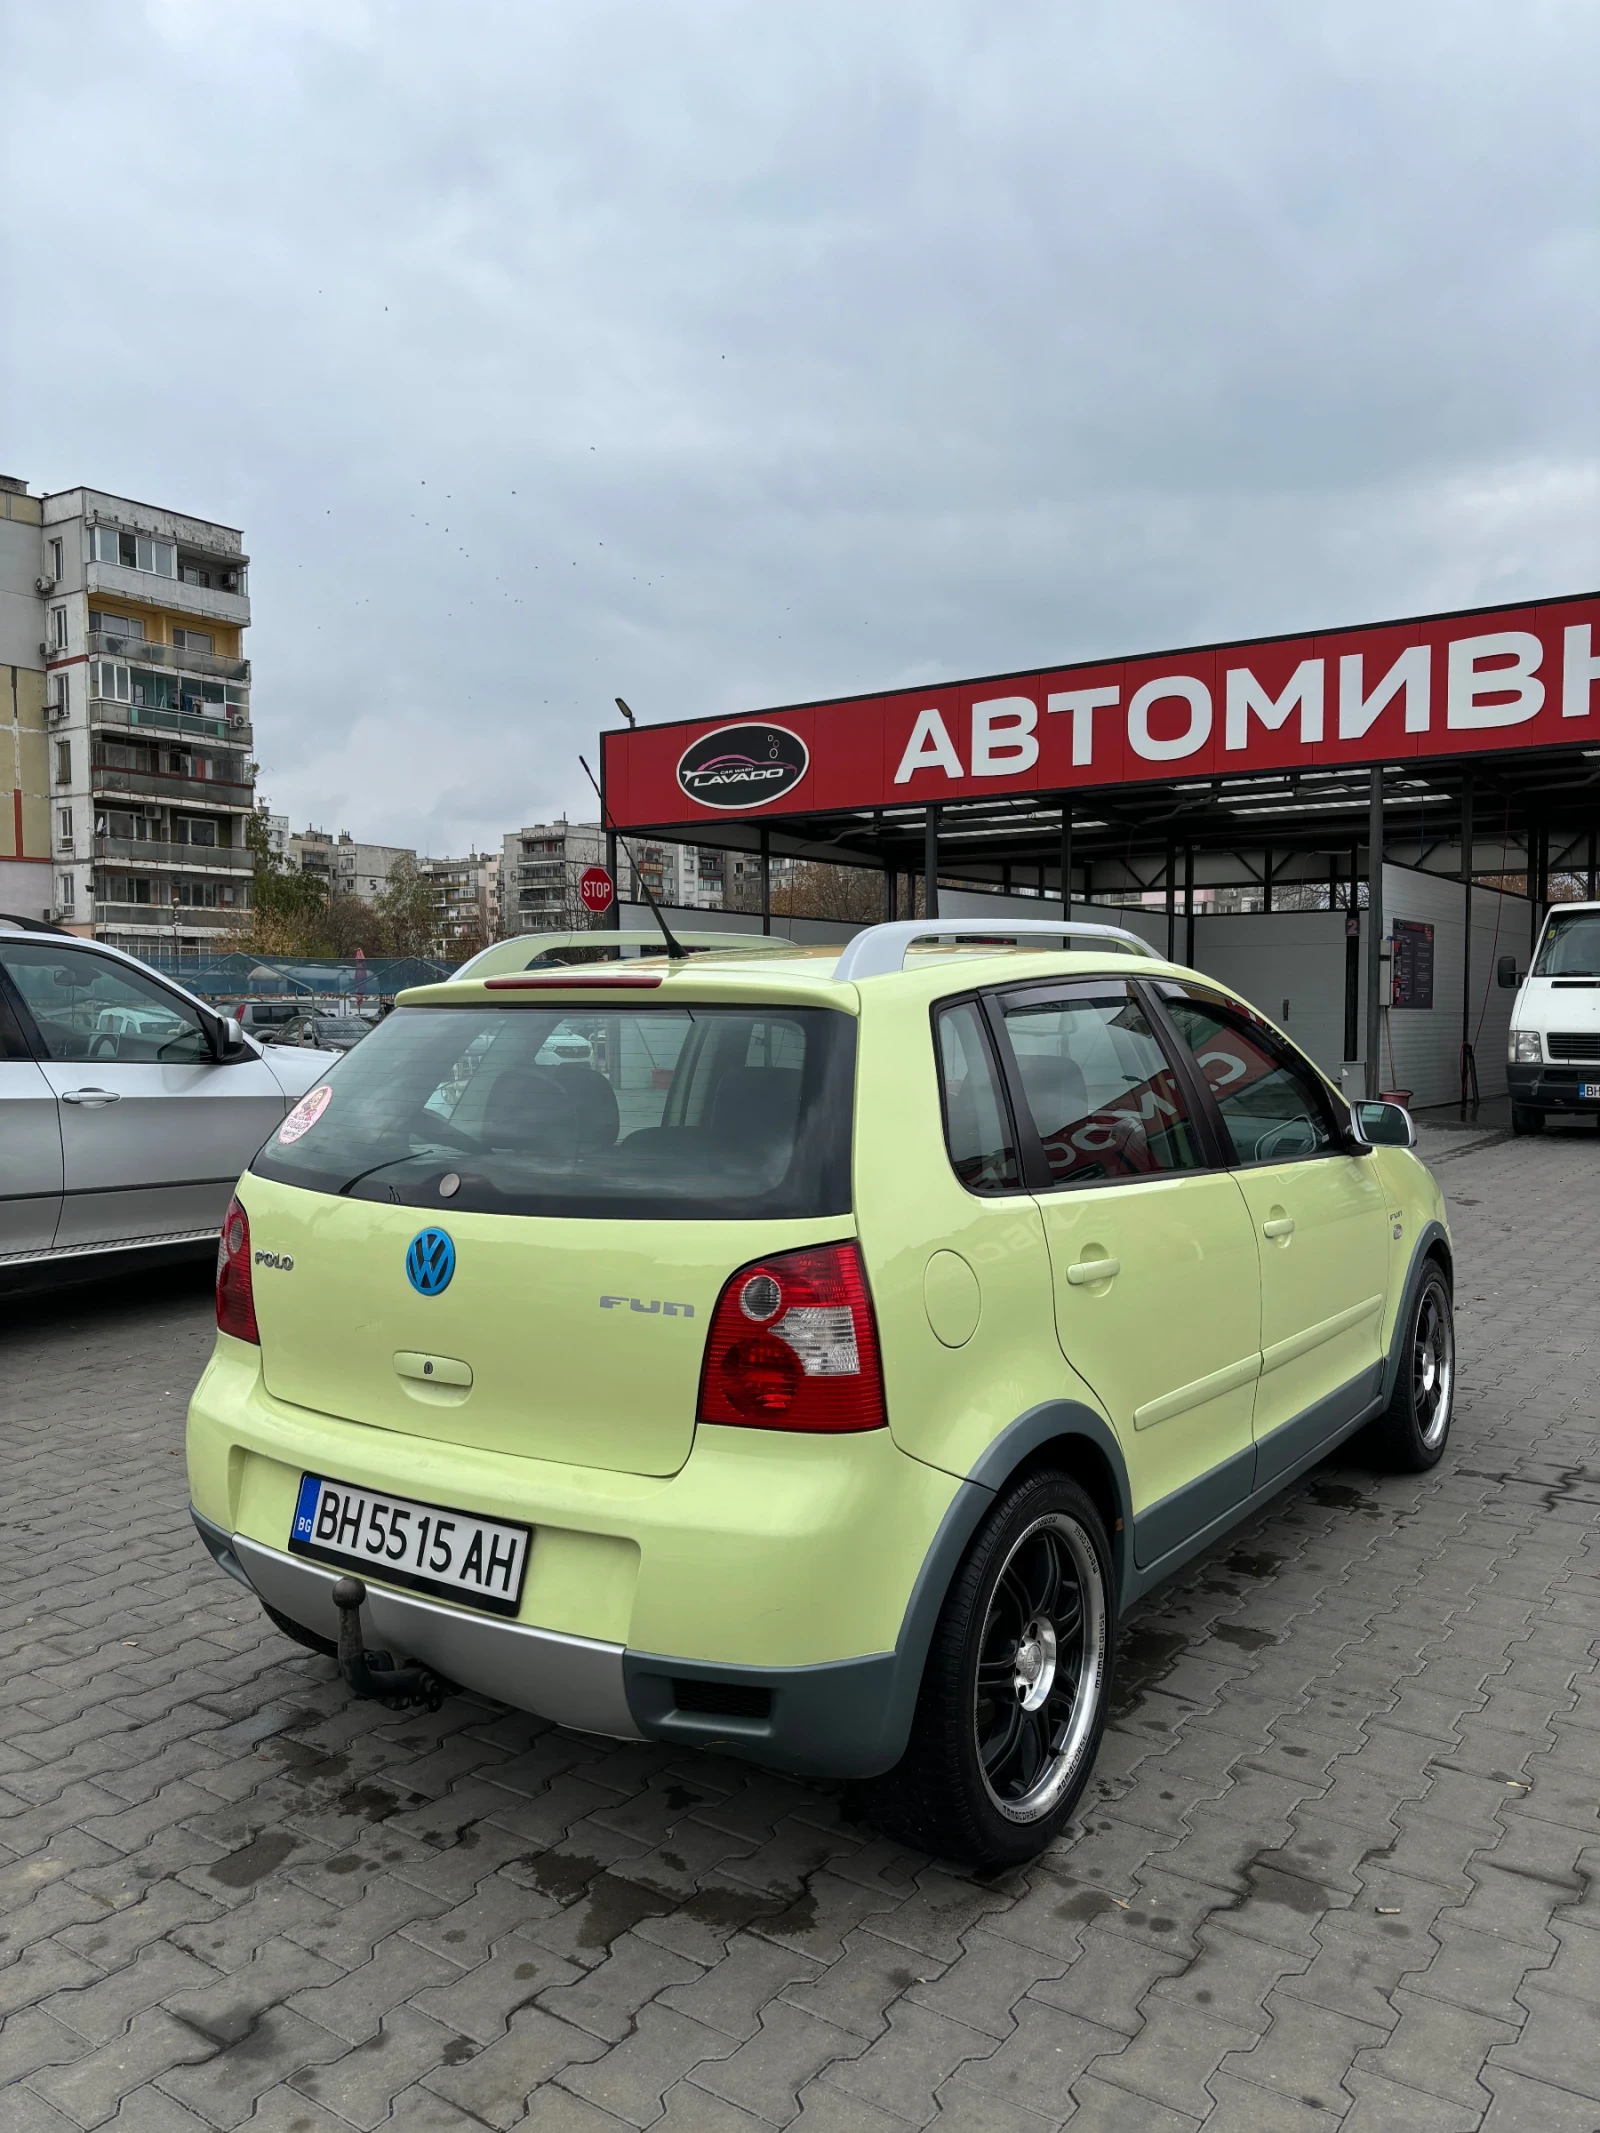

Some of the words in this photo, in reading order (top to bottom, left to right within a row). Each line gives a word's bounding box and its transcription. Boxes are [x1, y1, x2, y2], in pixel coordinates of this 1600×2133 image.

[694, 769, 783, 787] LAVADO
[369, 880, 377, 891] 5
[583, 881, 610, 899] STOP
[1347, 919, 1358, 935] 2
[254, 1249, 294, 1271] POLO
[297, 1516, 312, 1534] BG
